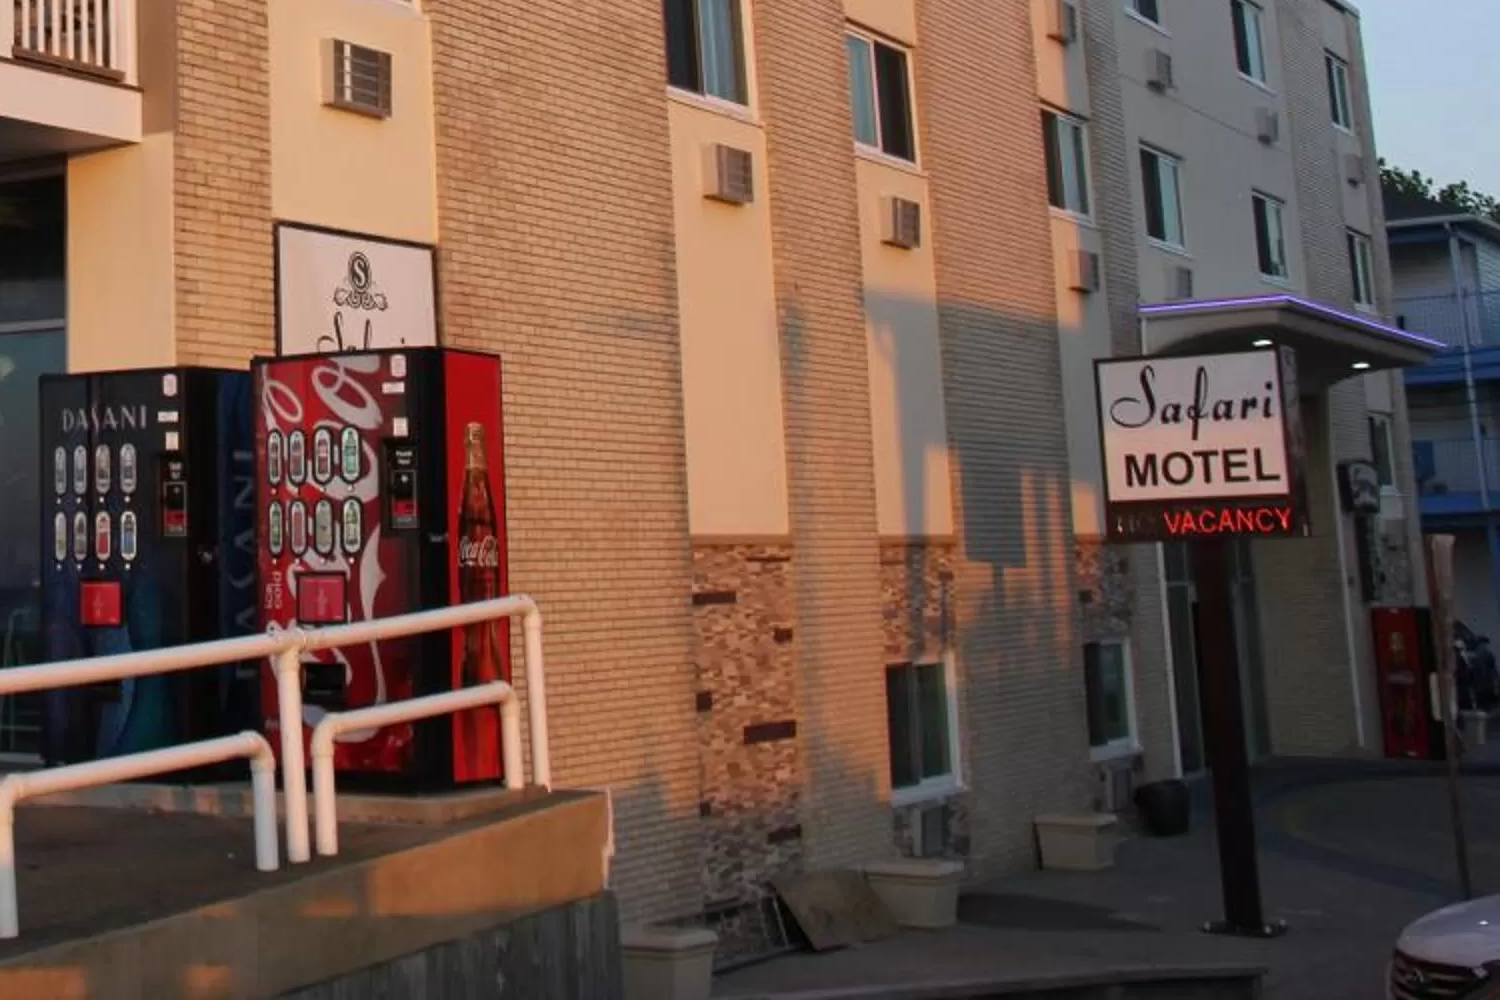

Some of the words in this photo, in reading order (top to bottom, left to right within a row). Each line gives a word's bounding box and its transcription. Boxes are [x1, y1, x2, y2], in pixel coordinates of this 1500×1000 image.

[62, 404, 148, 433] DASANI
[1110, 364, 1273, 441] Safari
[1124, 448, 1282, 488] MOTEL
[1163, 507, 1292, 534] VACANCY
